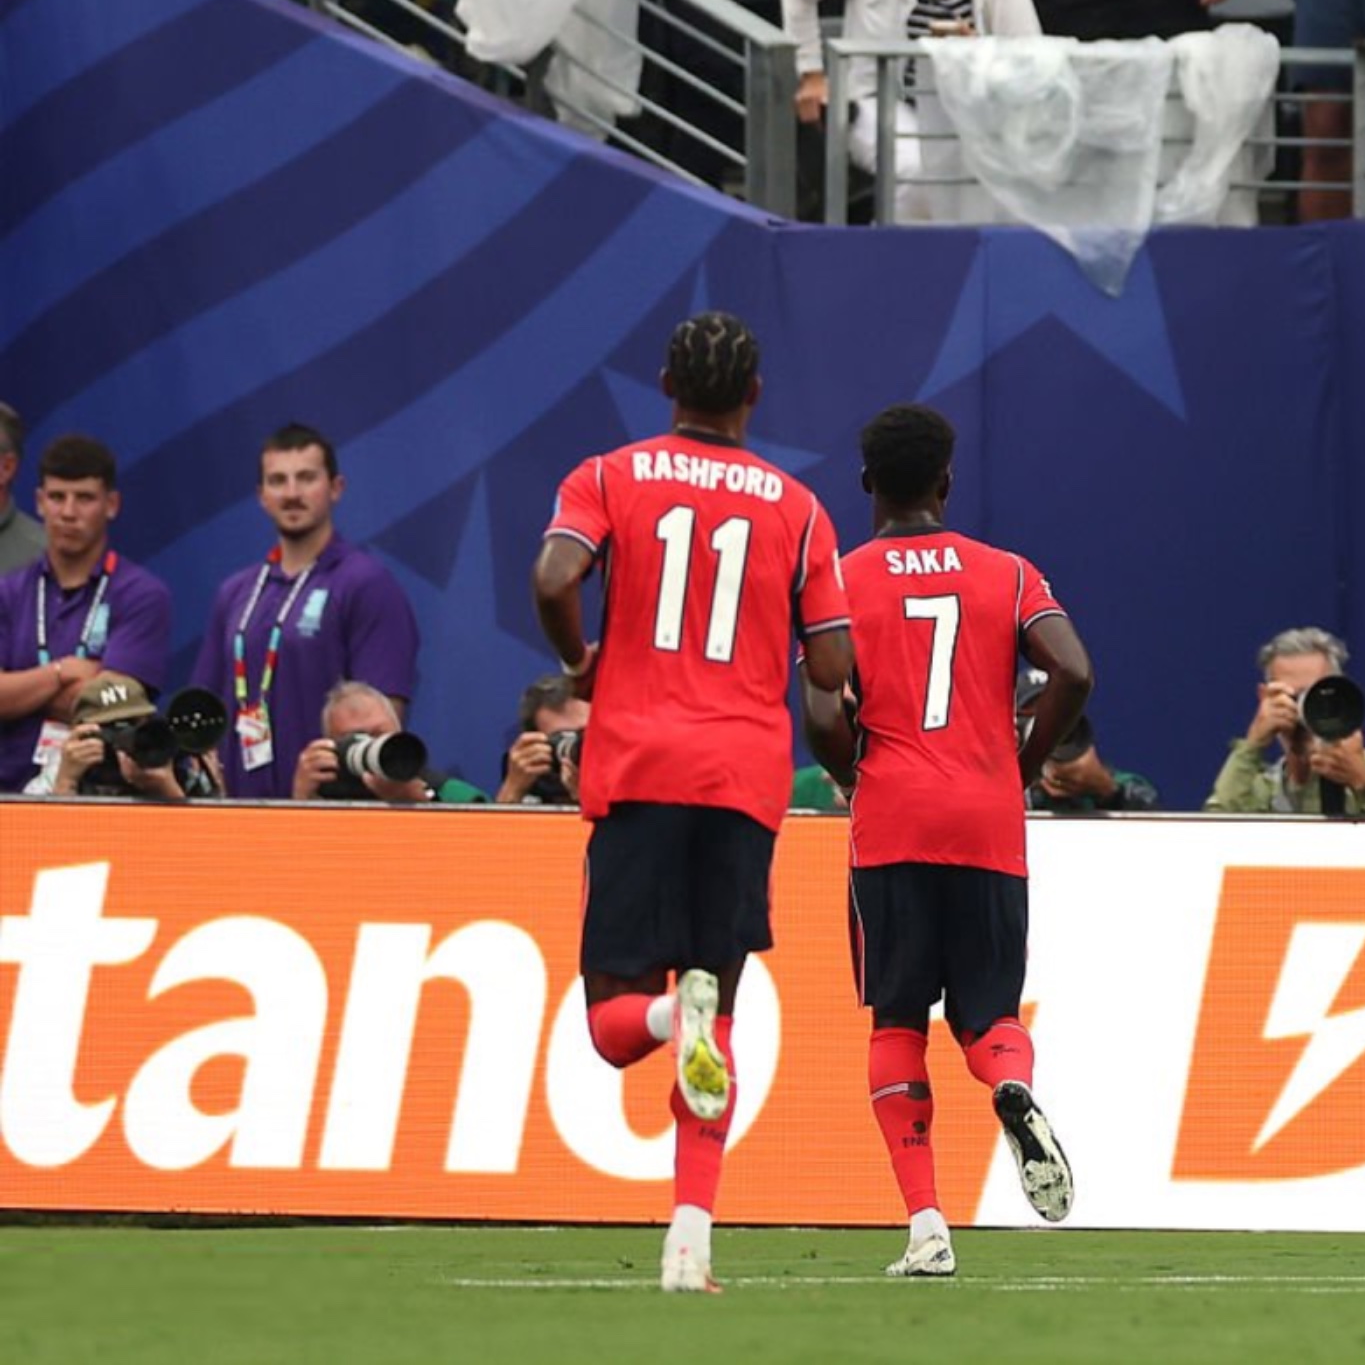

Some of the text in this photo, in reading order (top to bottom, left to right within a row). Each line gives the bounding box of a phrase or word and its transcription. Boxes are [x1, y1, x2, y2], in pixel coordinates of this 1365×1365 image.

[632, 450, 783, 502] RASHFORD
[654, 503, 752, 663] 11
[885, 546, 963, 575] SAKA
[903, 592, 962, 731] 7
[100, 684, 129, 706] NY
